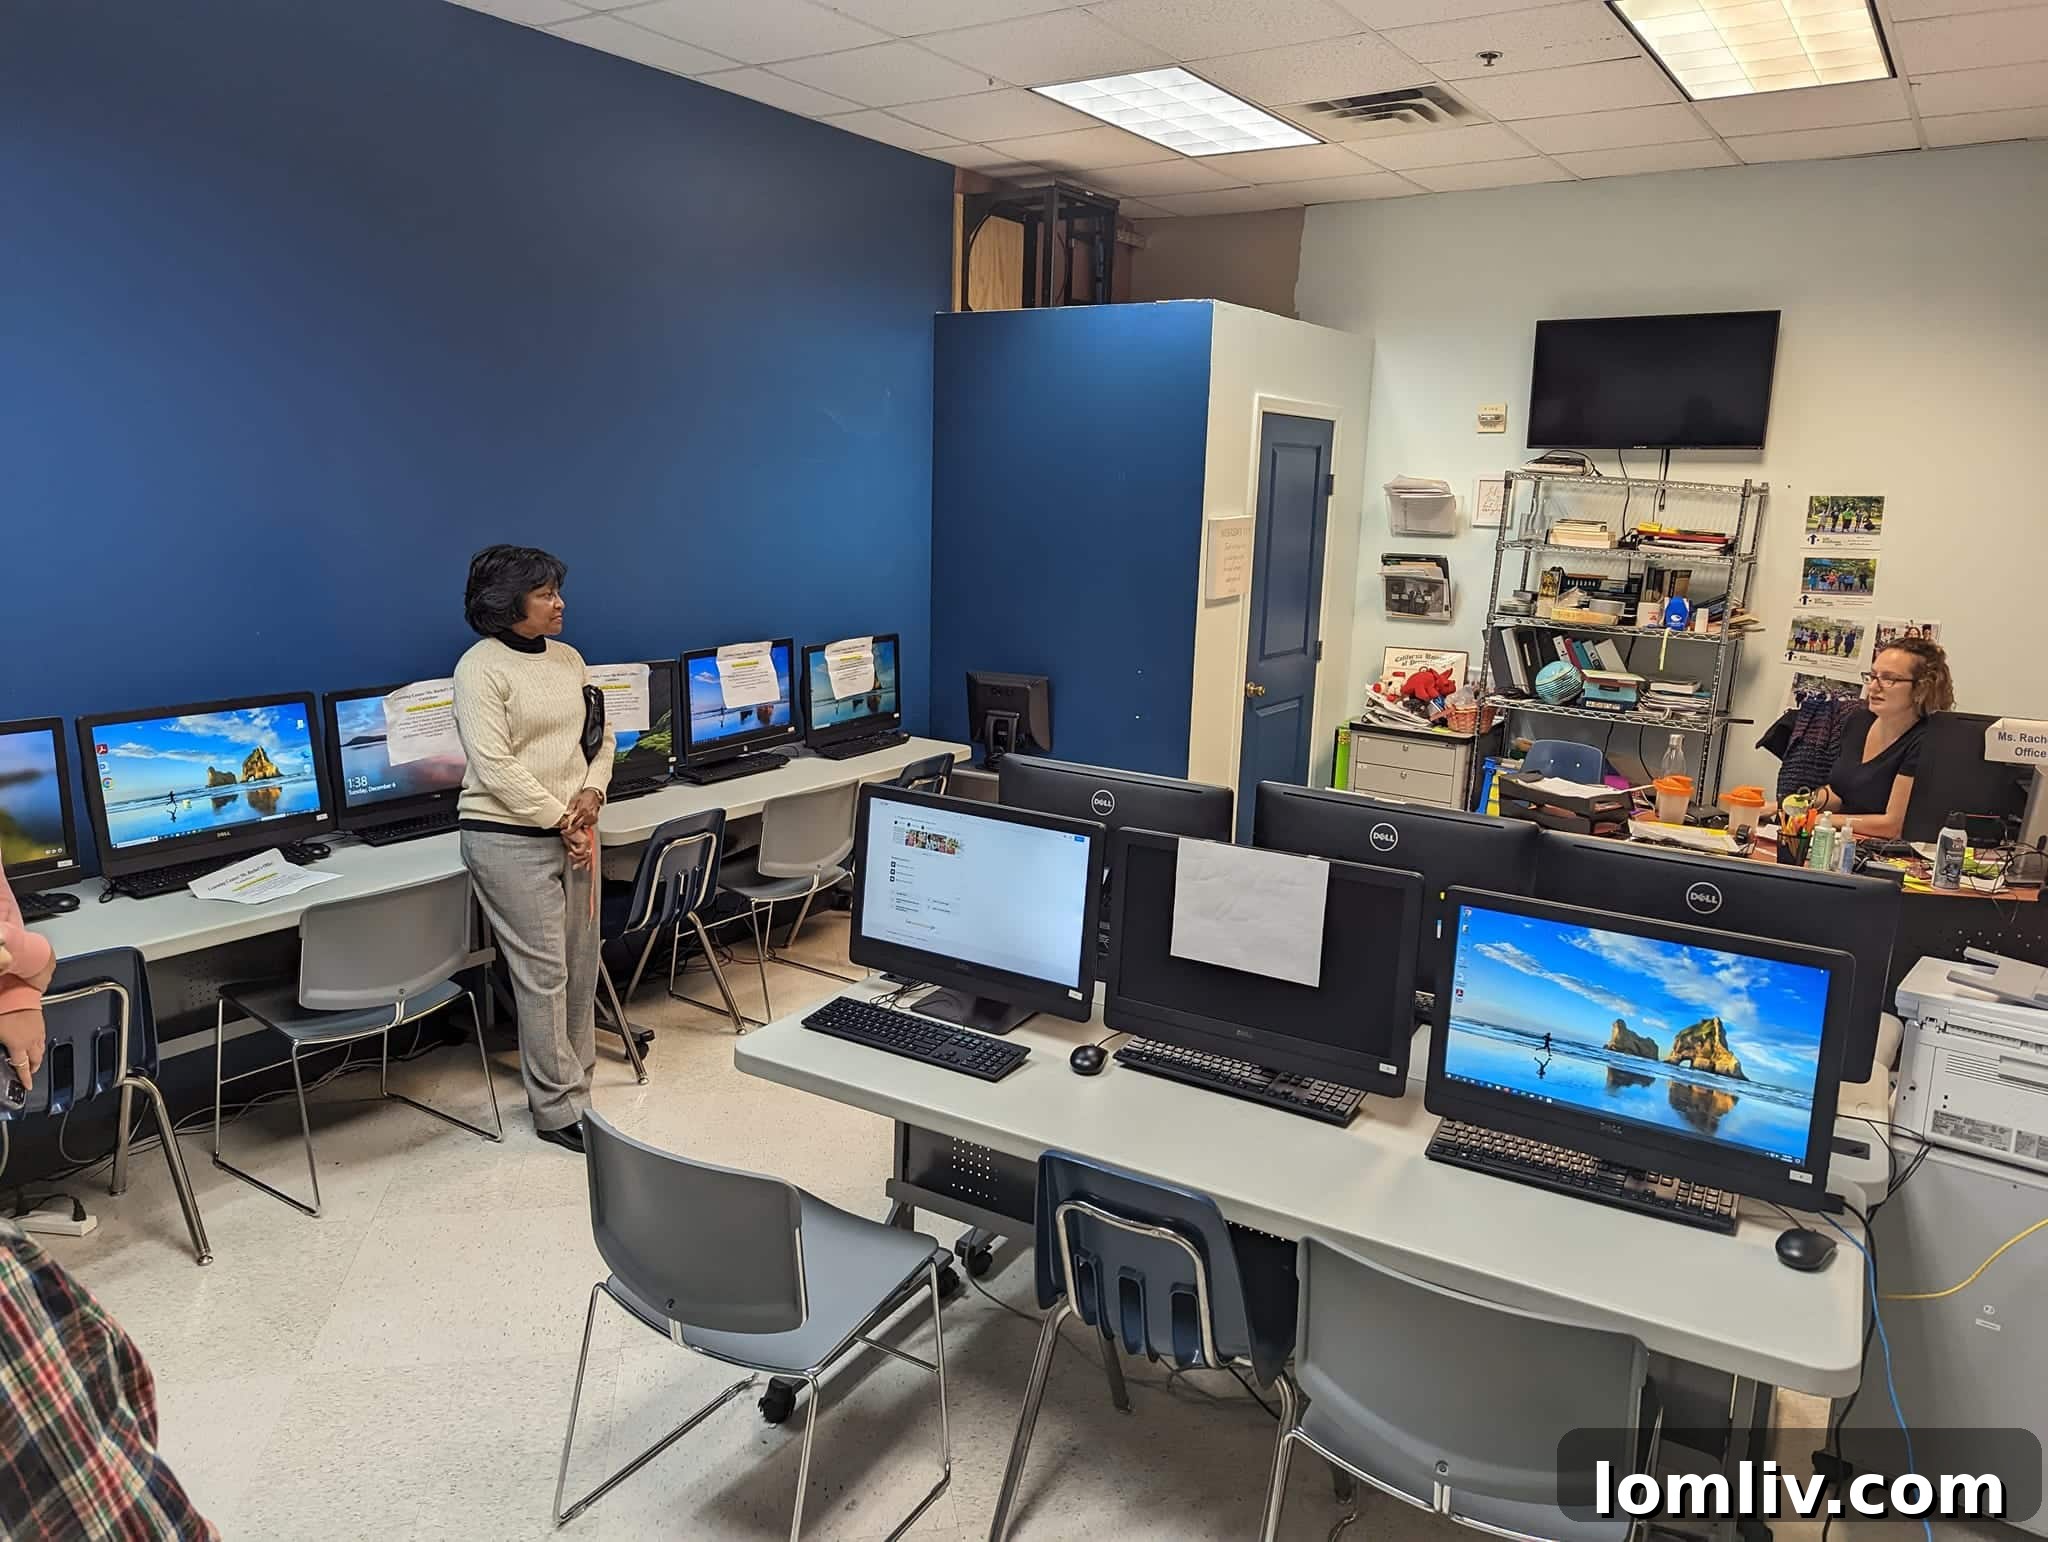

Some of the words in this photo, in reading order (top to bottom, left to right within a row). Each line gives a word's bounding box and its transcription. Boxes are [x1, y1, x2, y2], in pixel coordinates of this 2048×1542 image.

[1998, 731, 2016, 742] Ms.
[2014, 746, 2047, 758] Office
[347, 776, 368, 788] 1:38
[1094, 798, 1113, 807] DELL
[1373, 832, 1394, 841] DELL
[1690, 892, 1718, 904] DELL
